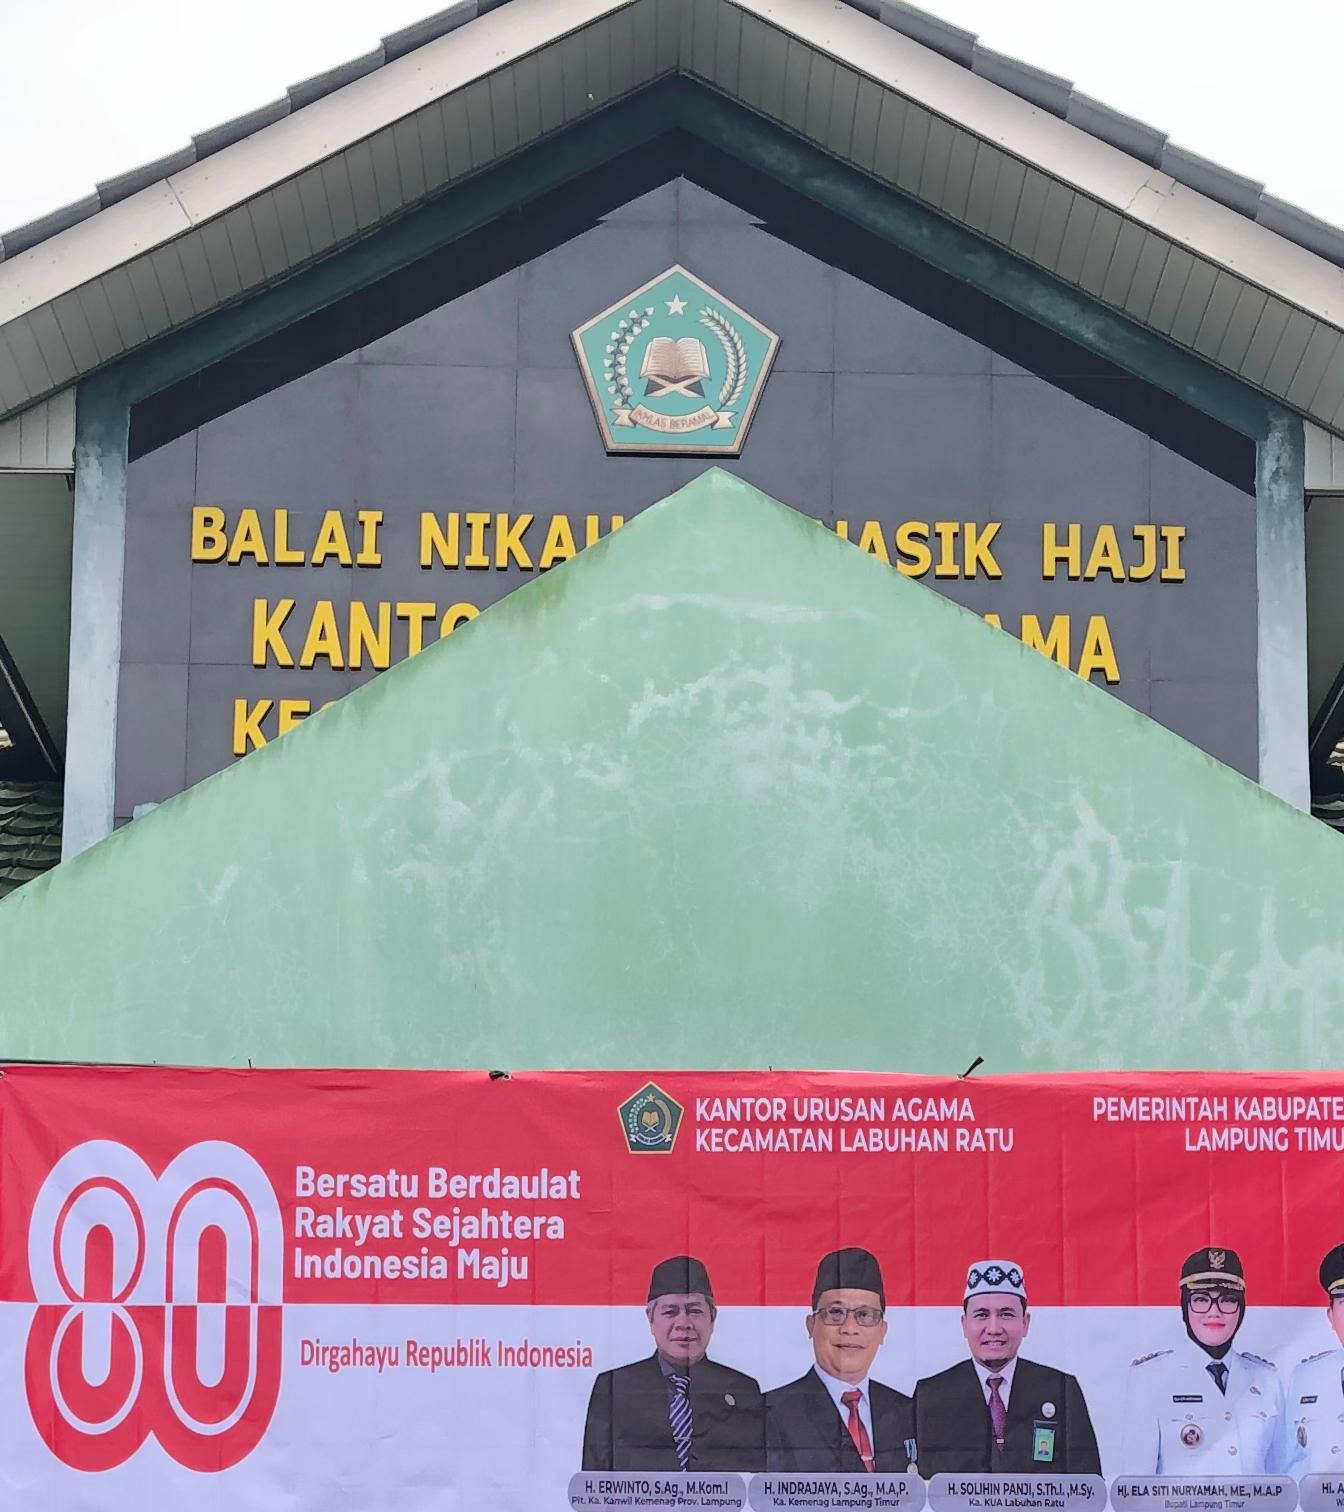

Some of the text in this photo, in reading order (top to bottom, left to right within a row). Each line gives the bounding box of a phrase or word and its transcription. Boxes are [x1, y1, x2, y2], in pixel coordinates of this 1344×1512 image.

[191, 506, 384, 568] BALAI
[836, 520, 1002, 581] ASIK
[1042, 522, 1186, 584] HAJI
[695, 1097, 976, 1122] KANTOR URUSAN AGAMA
[1092, 1096, 1228, 1122] PEMERINTAH
[695, 1127, 834, 1153] KECAMATAN
[840, 1127, 949, 1153] LABUHAN
[955, 1127, 1014, 1153] RATU
[1184, 1126, 1290, 1152] LAMPUNG
[295, 1165, 581, 1200] Bersatu Berdaulat
[294, 1206, 565, 1247] Rakyat Sejahtera
[293, 1247, 529, 1288] Indonesia Maju
[300, 1338, 593, 1373] Dirgahayu Republik Indonesia
[585, 1480, 596, 1494] H.
[599, 1480, 652, 1497] ERWINTO,
[764, 1482, 775, 1495] H.
[777, 1481, 842, 1498] INDRAJAYA,
[948, 1482, 958, 1496] H.
[960, 1483, 1000, 1496] SOLIHIN
[1003, 1483, 1034, 1499] PANJI,
[1131, 1485, 1150, 1497] ELA
[1152, 1485, 1170, 1497] SITI
[603, 1495, 633, 1505] Kanwil
[634, 1496, 676, 1508] Kemenag
[700, 1497, 743, 1508] Lampung
[773, 1497, 900, 1509] Ka. Kemenag Lampung Timur
[968, 1499, 1065, 1508] Ka. KUA Labuhan Ratu
[1189, 1500, 1223, 1511] Lampung
[1224, 1500, 1246, 1509] Timur
